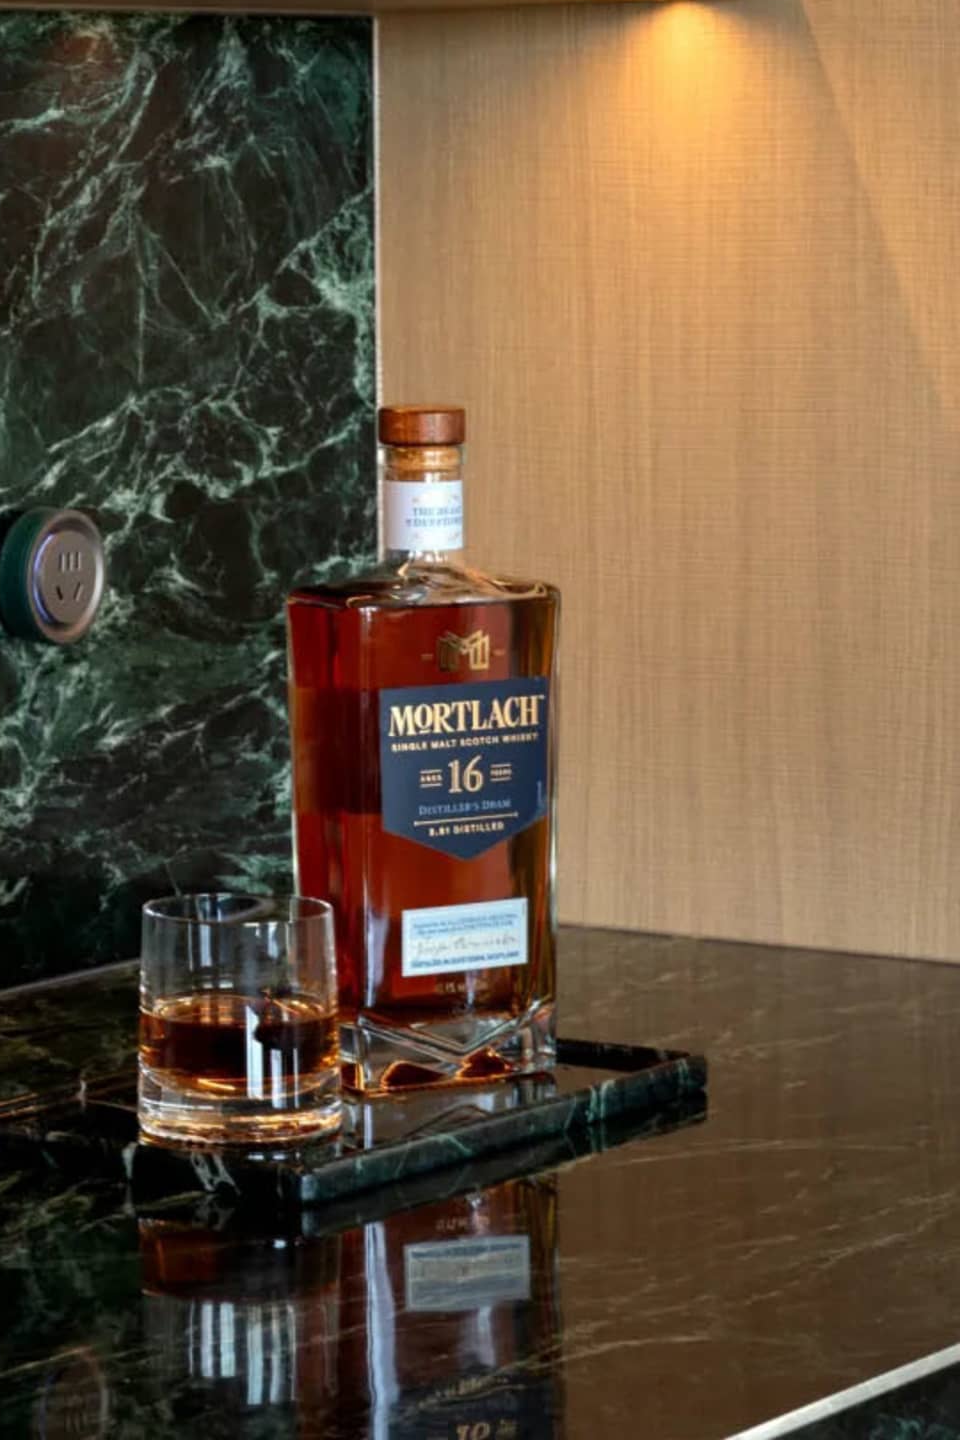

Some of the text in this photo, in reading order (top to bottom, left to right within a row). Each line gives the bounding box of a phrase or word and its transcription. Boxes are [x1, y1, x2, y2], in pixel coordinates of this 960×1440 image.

[388, 694, 540, 737] MORTLACH
[391, 741, 428, 752] SINGLE
[431, 738, 457, 750] MALT
[460, 735, 500, 747] SCOTCH
[448, 755, 483, 794] 16
[453, 821, 505, 834] DISTILLED
